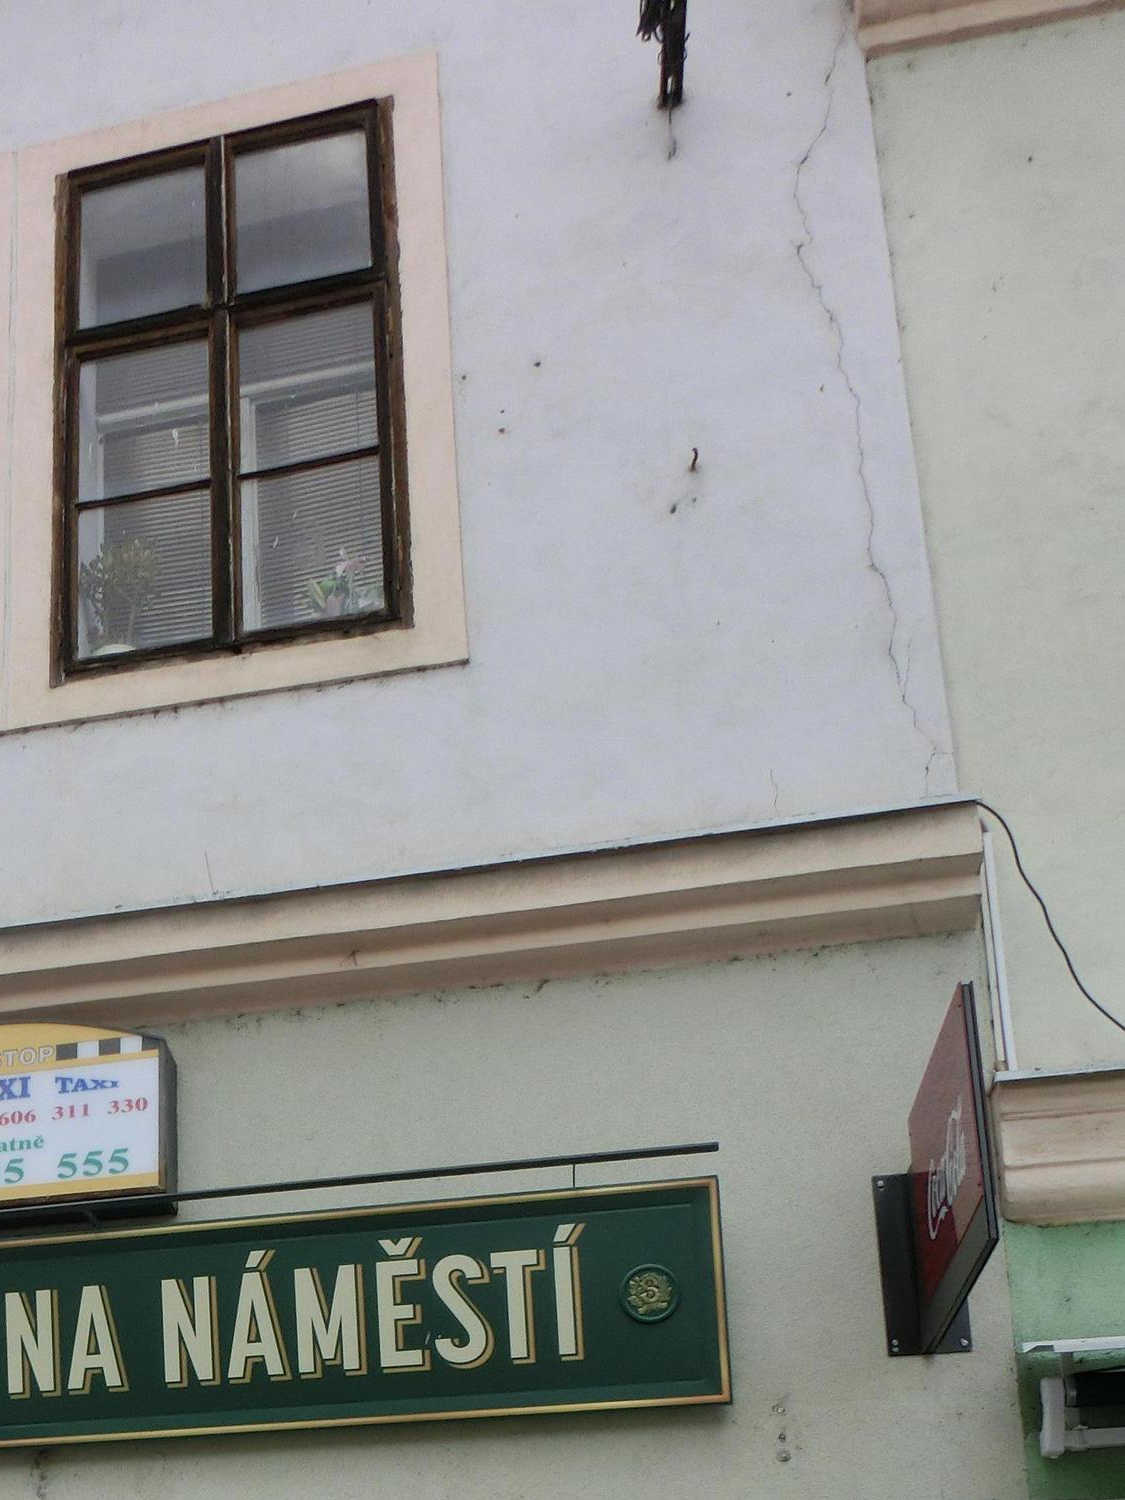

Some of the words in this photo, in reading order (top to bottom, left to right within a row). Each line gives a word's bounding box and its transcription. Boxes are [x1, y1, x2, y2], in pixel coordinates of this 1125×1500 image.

[55, 1076, 120, 1095] TAXI
[51, 1103, 91, 1121] 311
[107, 1097, 149, 1115] 330
[57, 1148, 130, 1180] 555
[5, 1284, 128, 1398] NA
[161, 1223, 586, 1388] NÁMĚSTÍ
